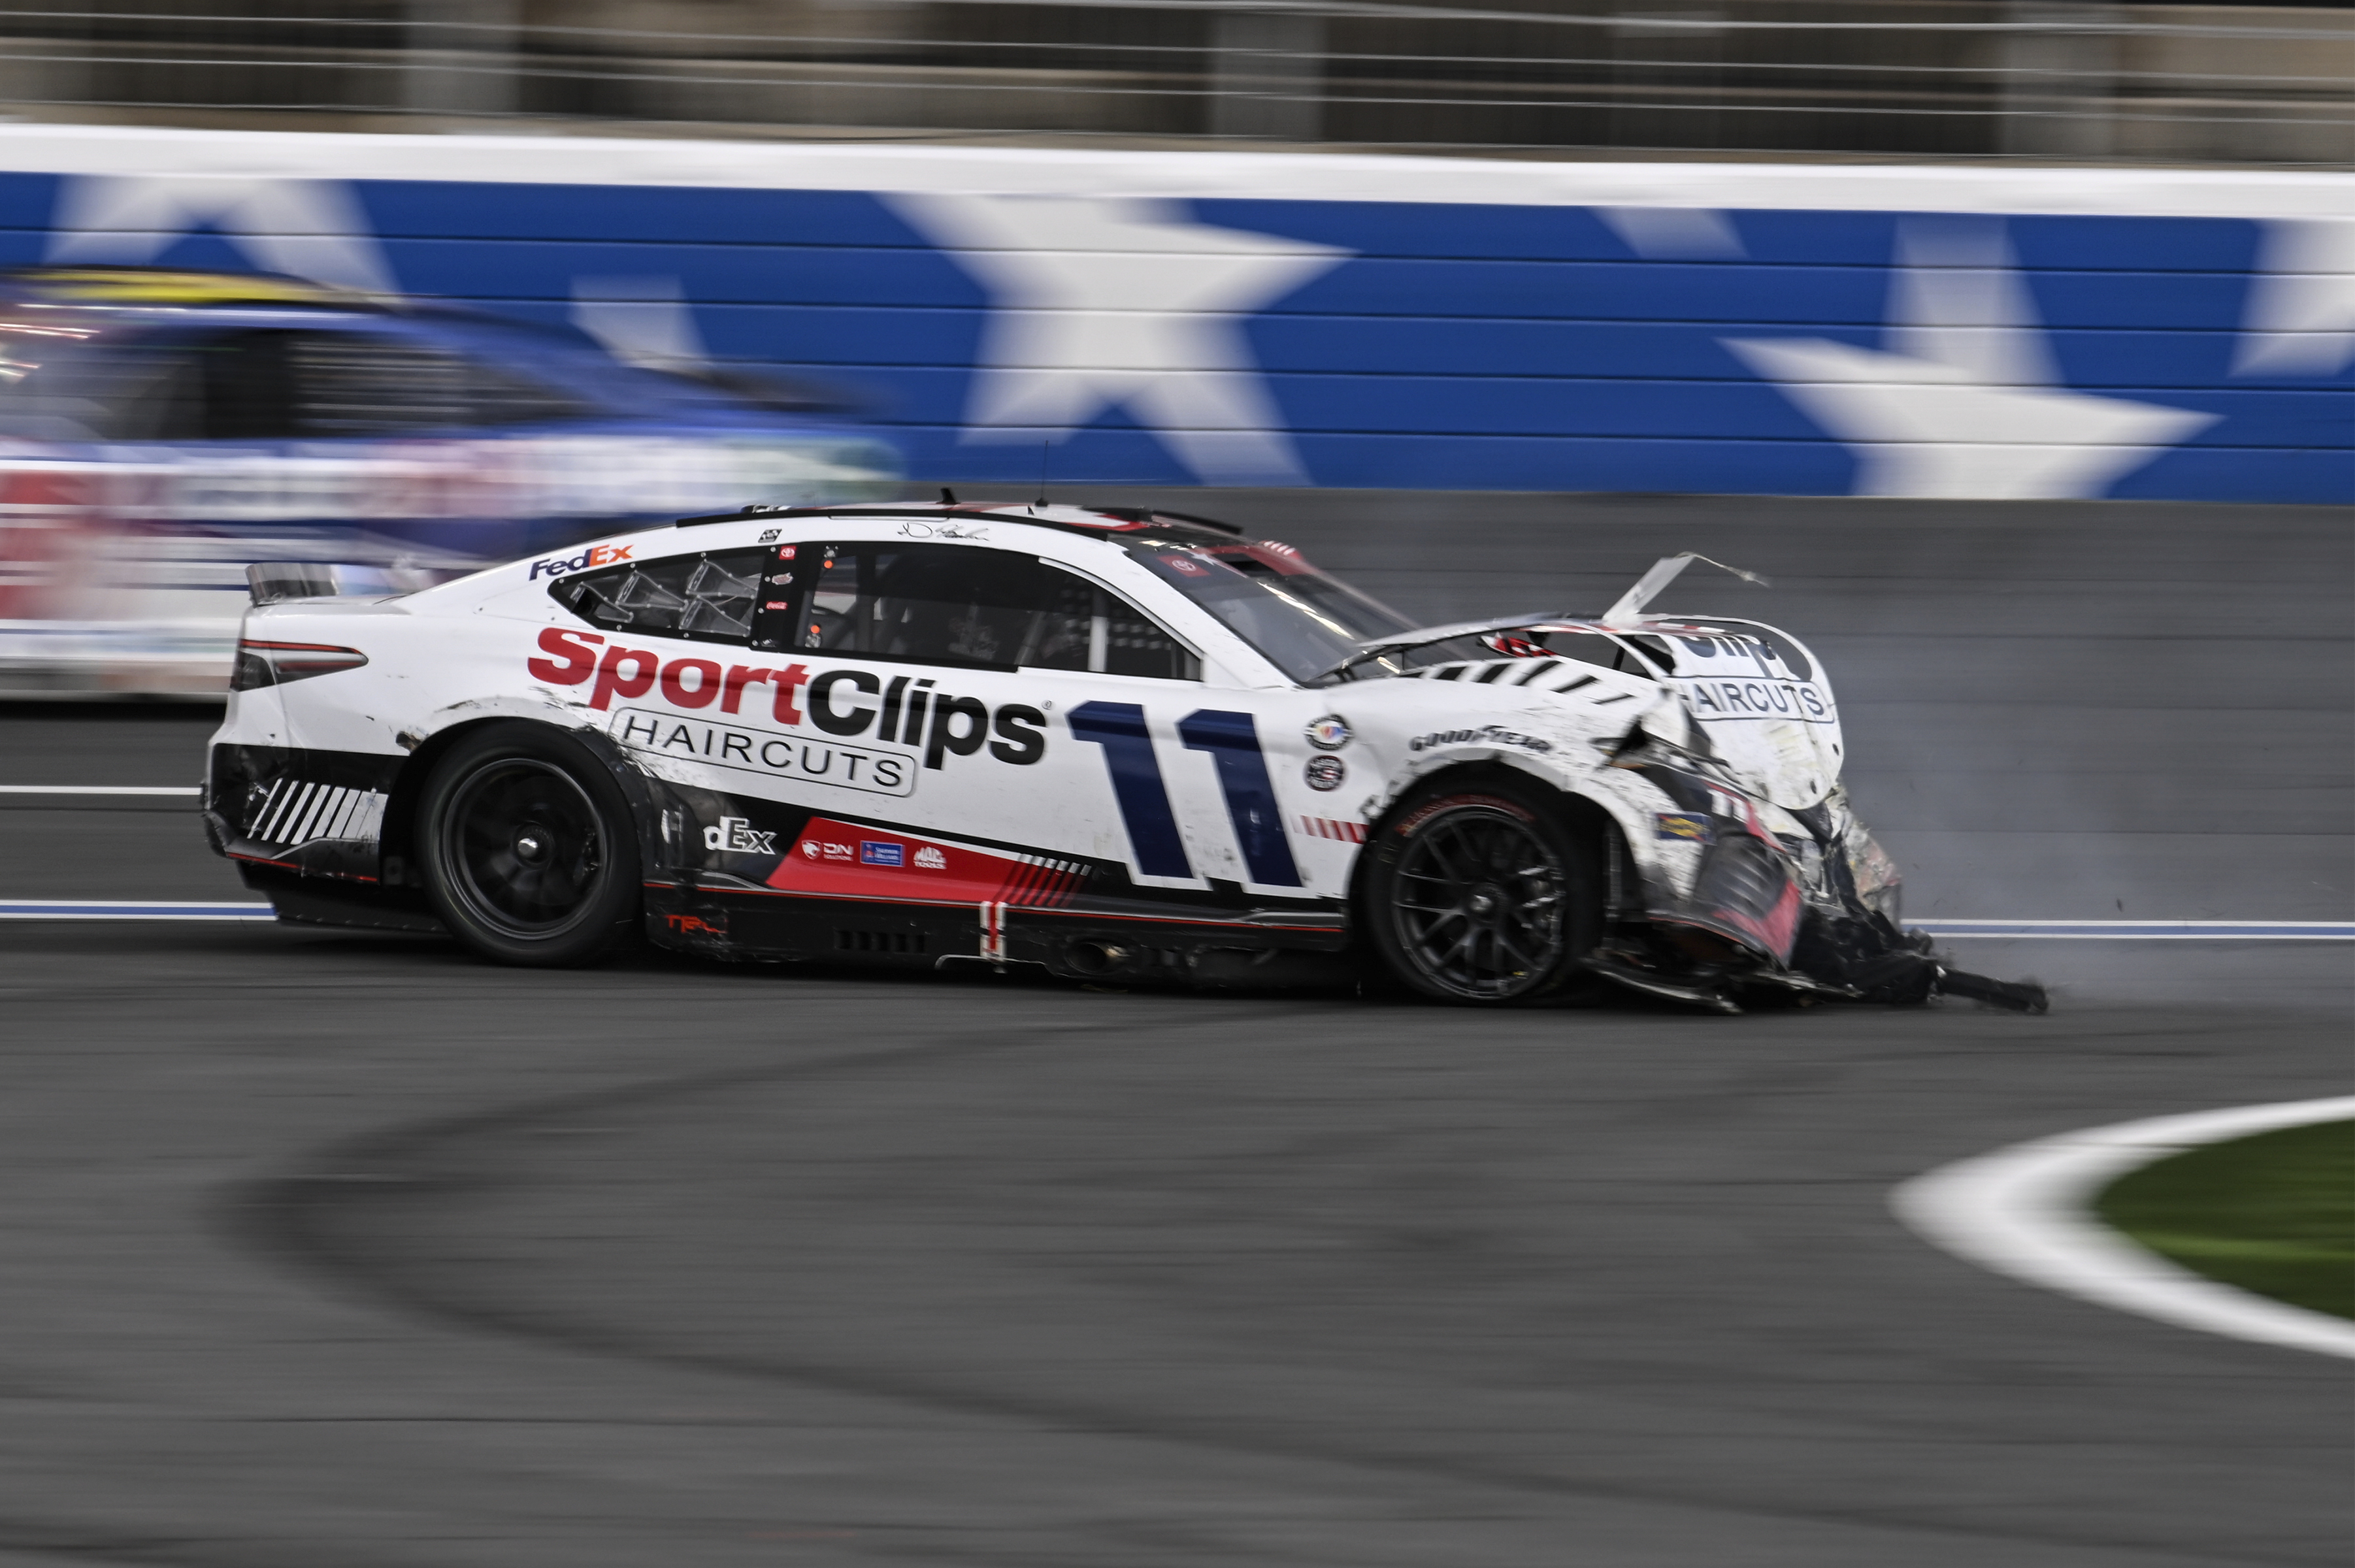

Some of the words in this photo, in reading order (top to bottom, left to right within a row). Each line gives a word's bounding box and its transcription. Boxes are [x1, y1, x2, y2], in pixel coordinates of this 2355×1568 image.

[529, 544, 634, 581] FedEx
[623, 713, 903, 788] HAIRCUTS
[1067, 700, 1302, 887] 11
[913, 846, 946, 864] MAC
